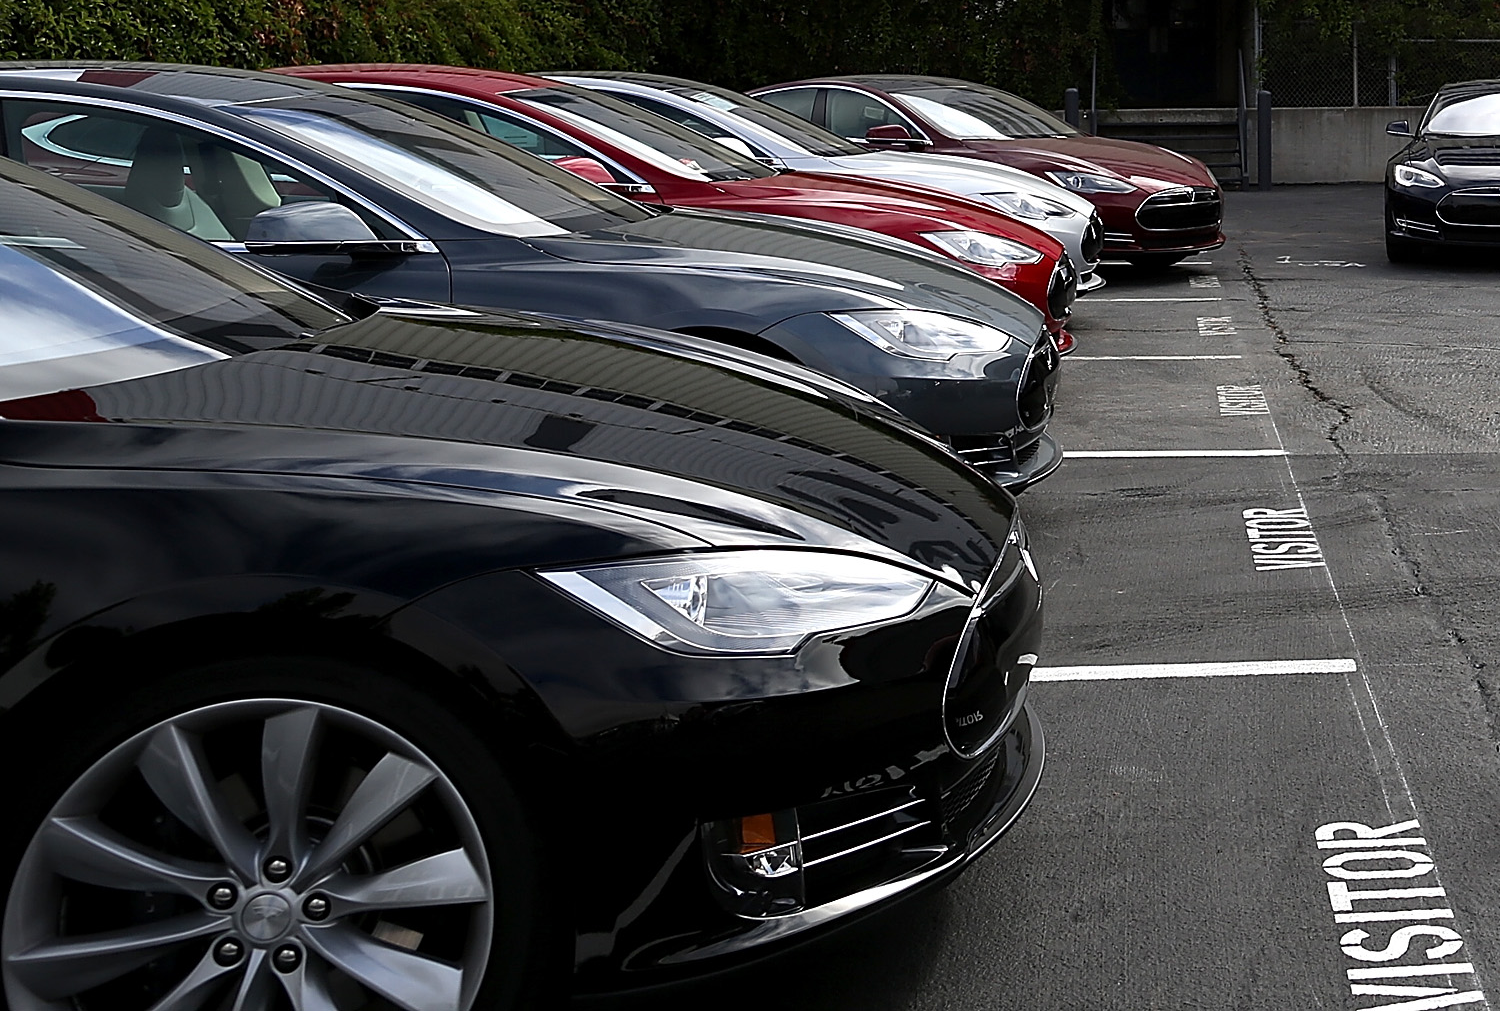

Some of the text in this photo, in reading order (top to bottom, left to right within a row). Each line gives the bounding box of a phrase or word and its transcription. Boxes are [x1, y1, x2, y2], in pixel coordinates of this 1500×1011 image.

[1216, 384, 1270, 416] VISITOR
[1242, 508, 1326, 571] VISITOR
[1315, 819, 1485, 1011] VISITOR
